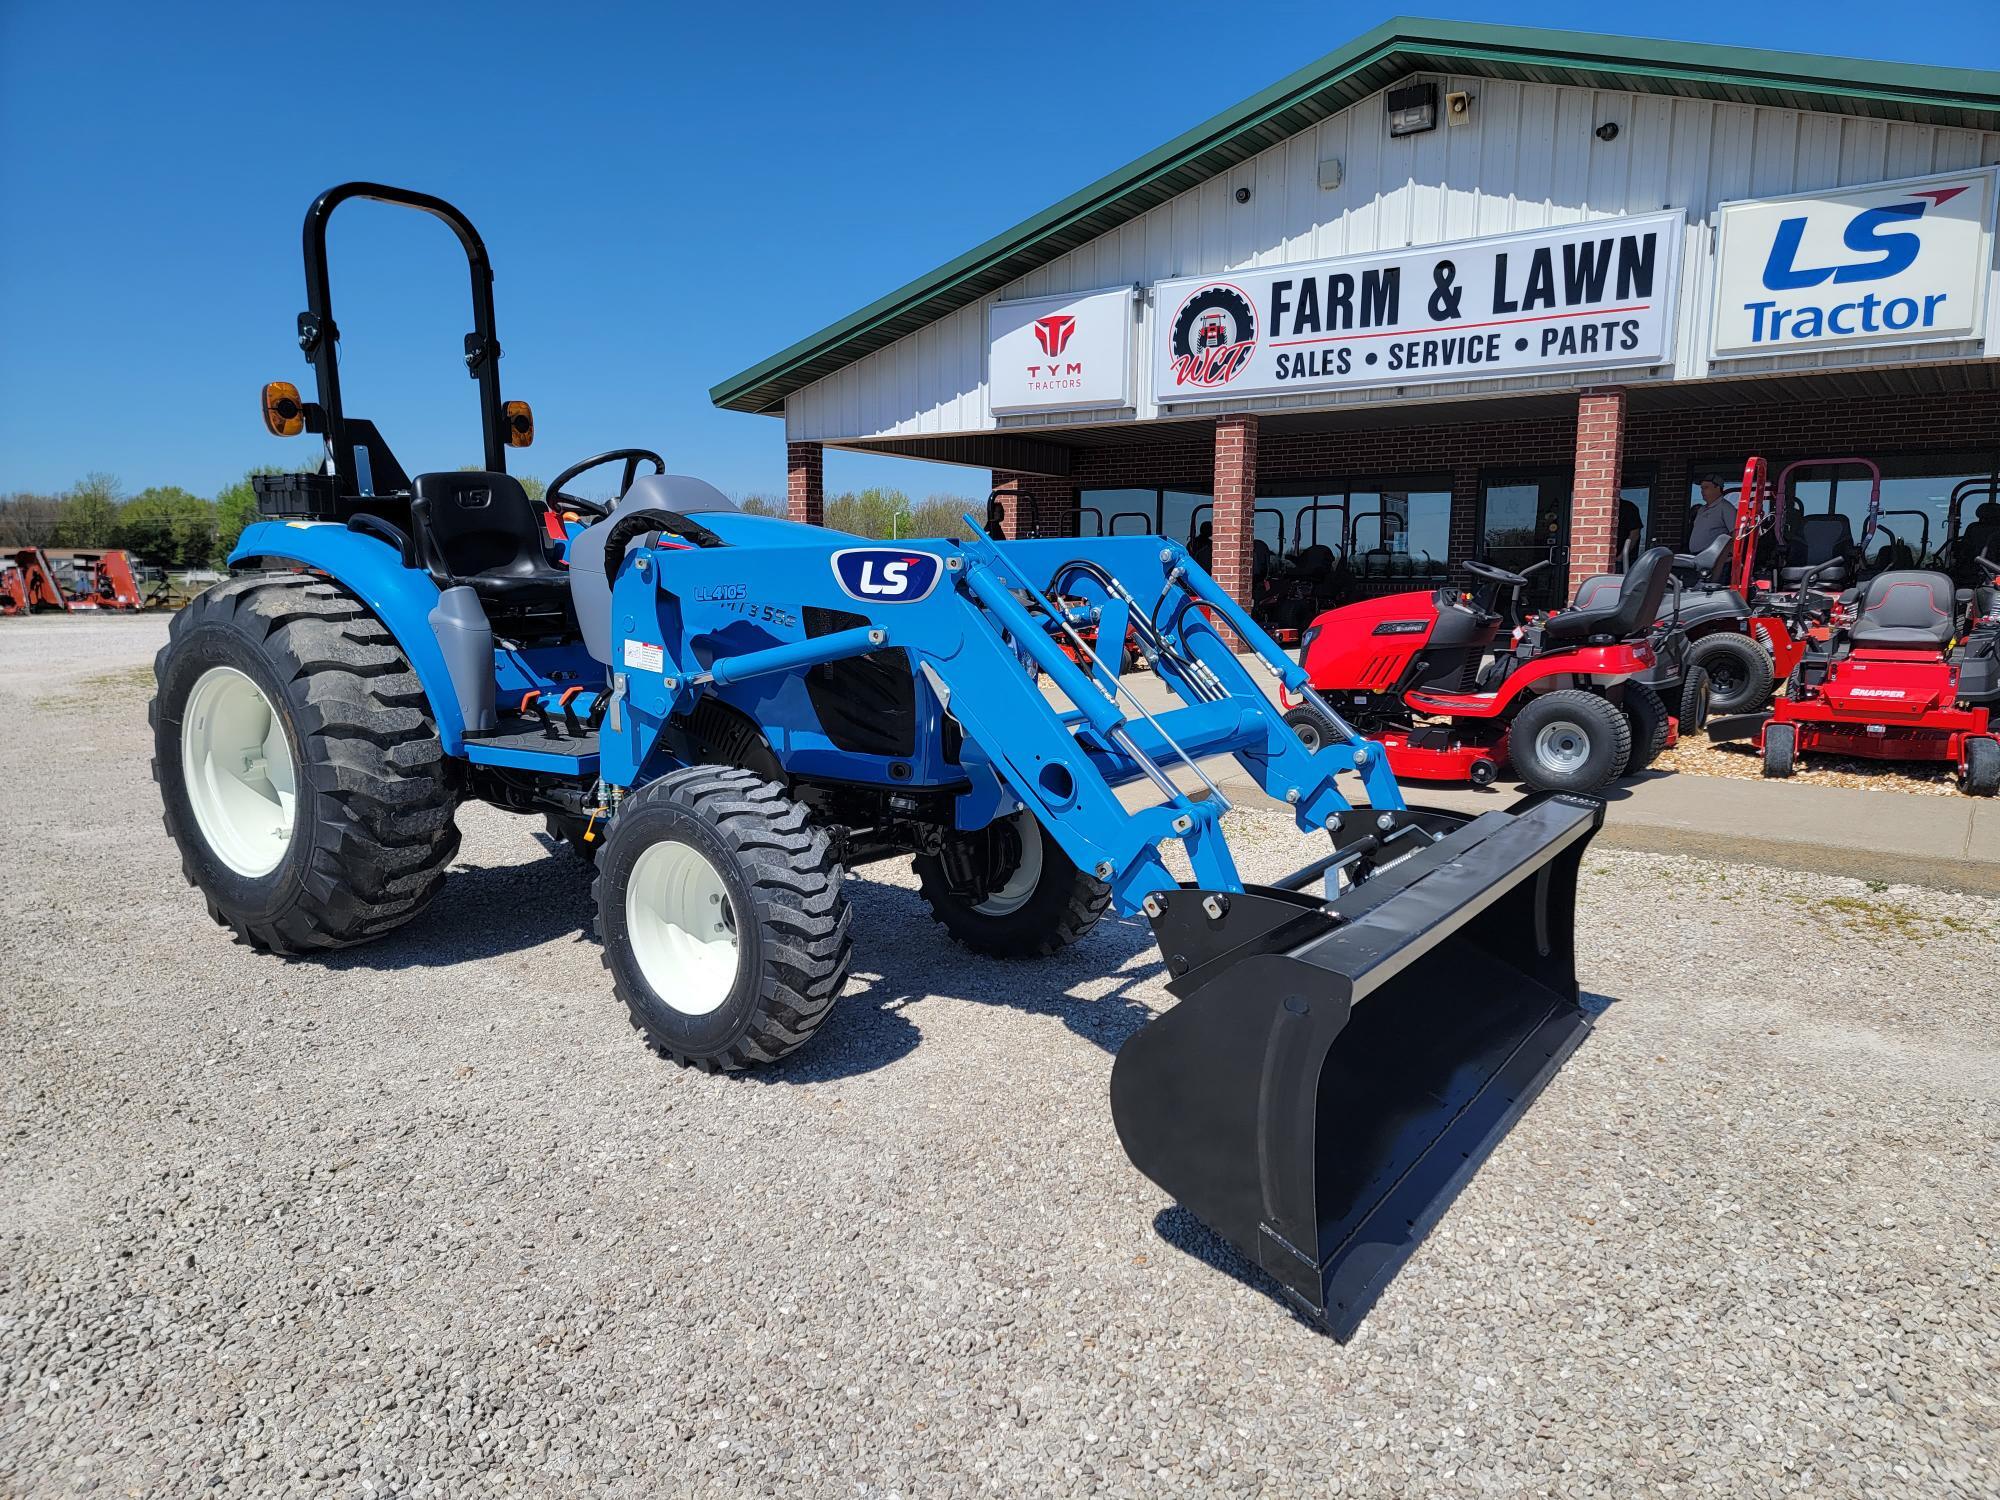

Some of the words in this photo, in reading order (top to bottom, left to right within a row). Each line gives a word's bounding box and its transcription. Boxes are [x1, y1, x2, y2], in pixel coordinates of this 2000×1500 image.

[1762, 201, 1926, 291] LS
[1269, 266, 1401, 338] FARM
[1427, 259, 1463, 322] &
[1492, 232, 1657, 315] LAWN
[1743, 292, 1947, 343] Tractor
[1170, 341, 1256, 386] WCT
[1275, 347, 1352, 380] SALES
[1387, 333, 1501, 371] SERVICE
[1540, 319, 1640, 358] PARTS
[1027, 362, 1082, 378] TYM
[1027, 378, 1081, 391] TRACTORS
[694, 583, 747, 601] LL4105
[859, 560, 909, 595] LS
[1849, 687, 1906, 699] SNAPPER
